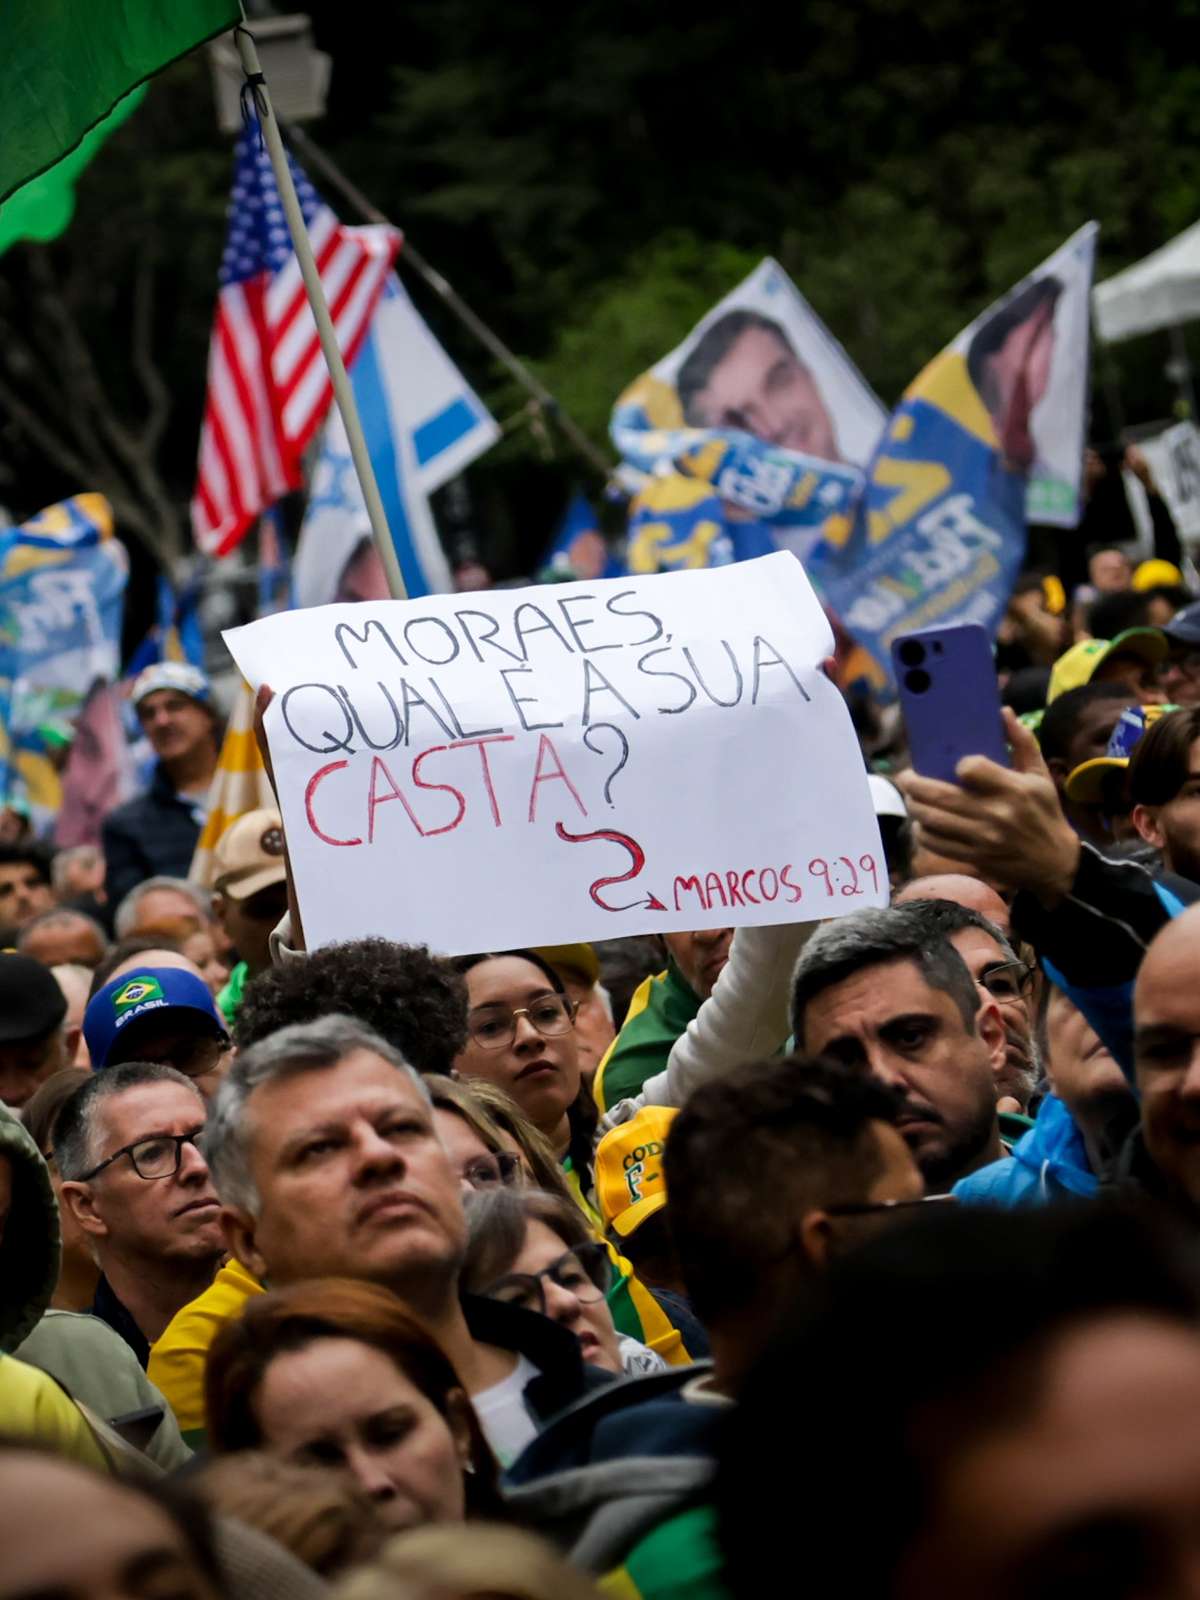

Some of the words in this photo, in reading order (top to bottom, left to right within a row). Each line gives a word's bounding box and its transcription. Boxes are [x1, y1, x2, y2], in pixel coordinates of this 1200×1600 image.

[334, 591, 673, 669] MORAES,
[281, 677, 504, 755] QUAL
[582, 658, 641, 726] A
[637, 635, 811, 714] SUA
[673, 864, 803, 912] MARCOS
[808, 854, 879, 897] 9:29
[115, 999, 169, 1028] BRASIL
